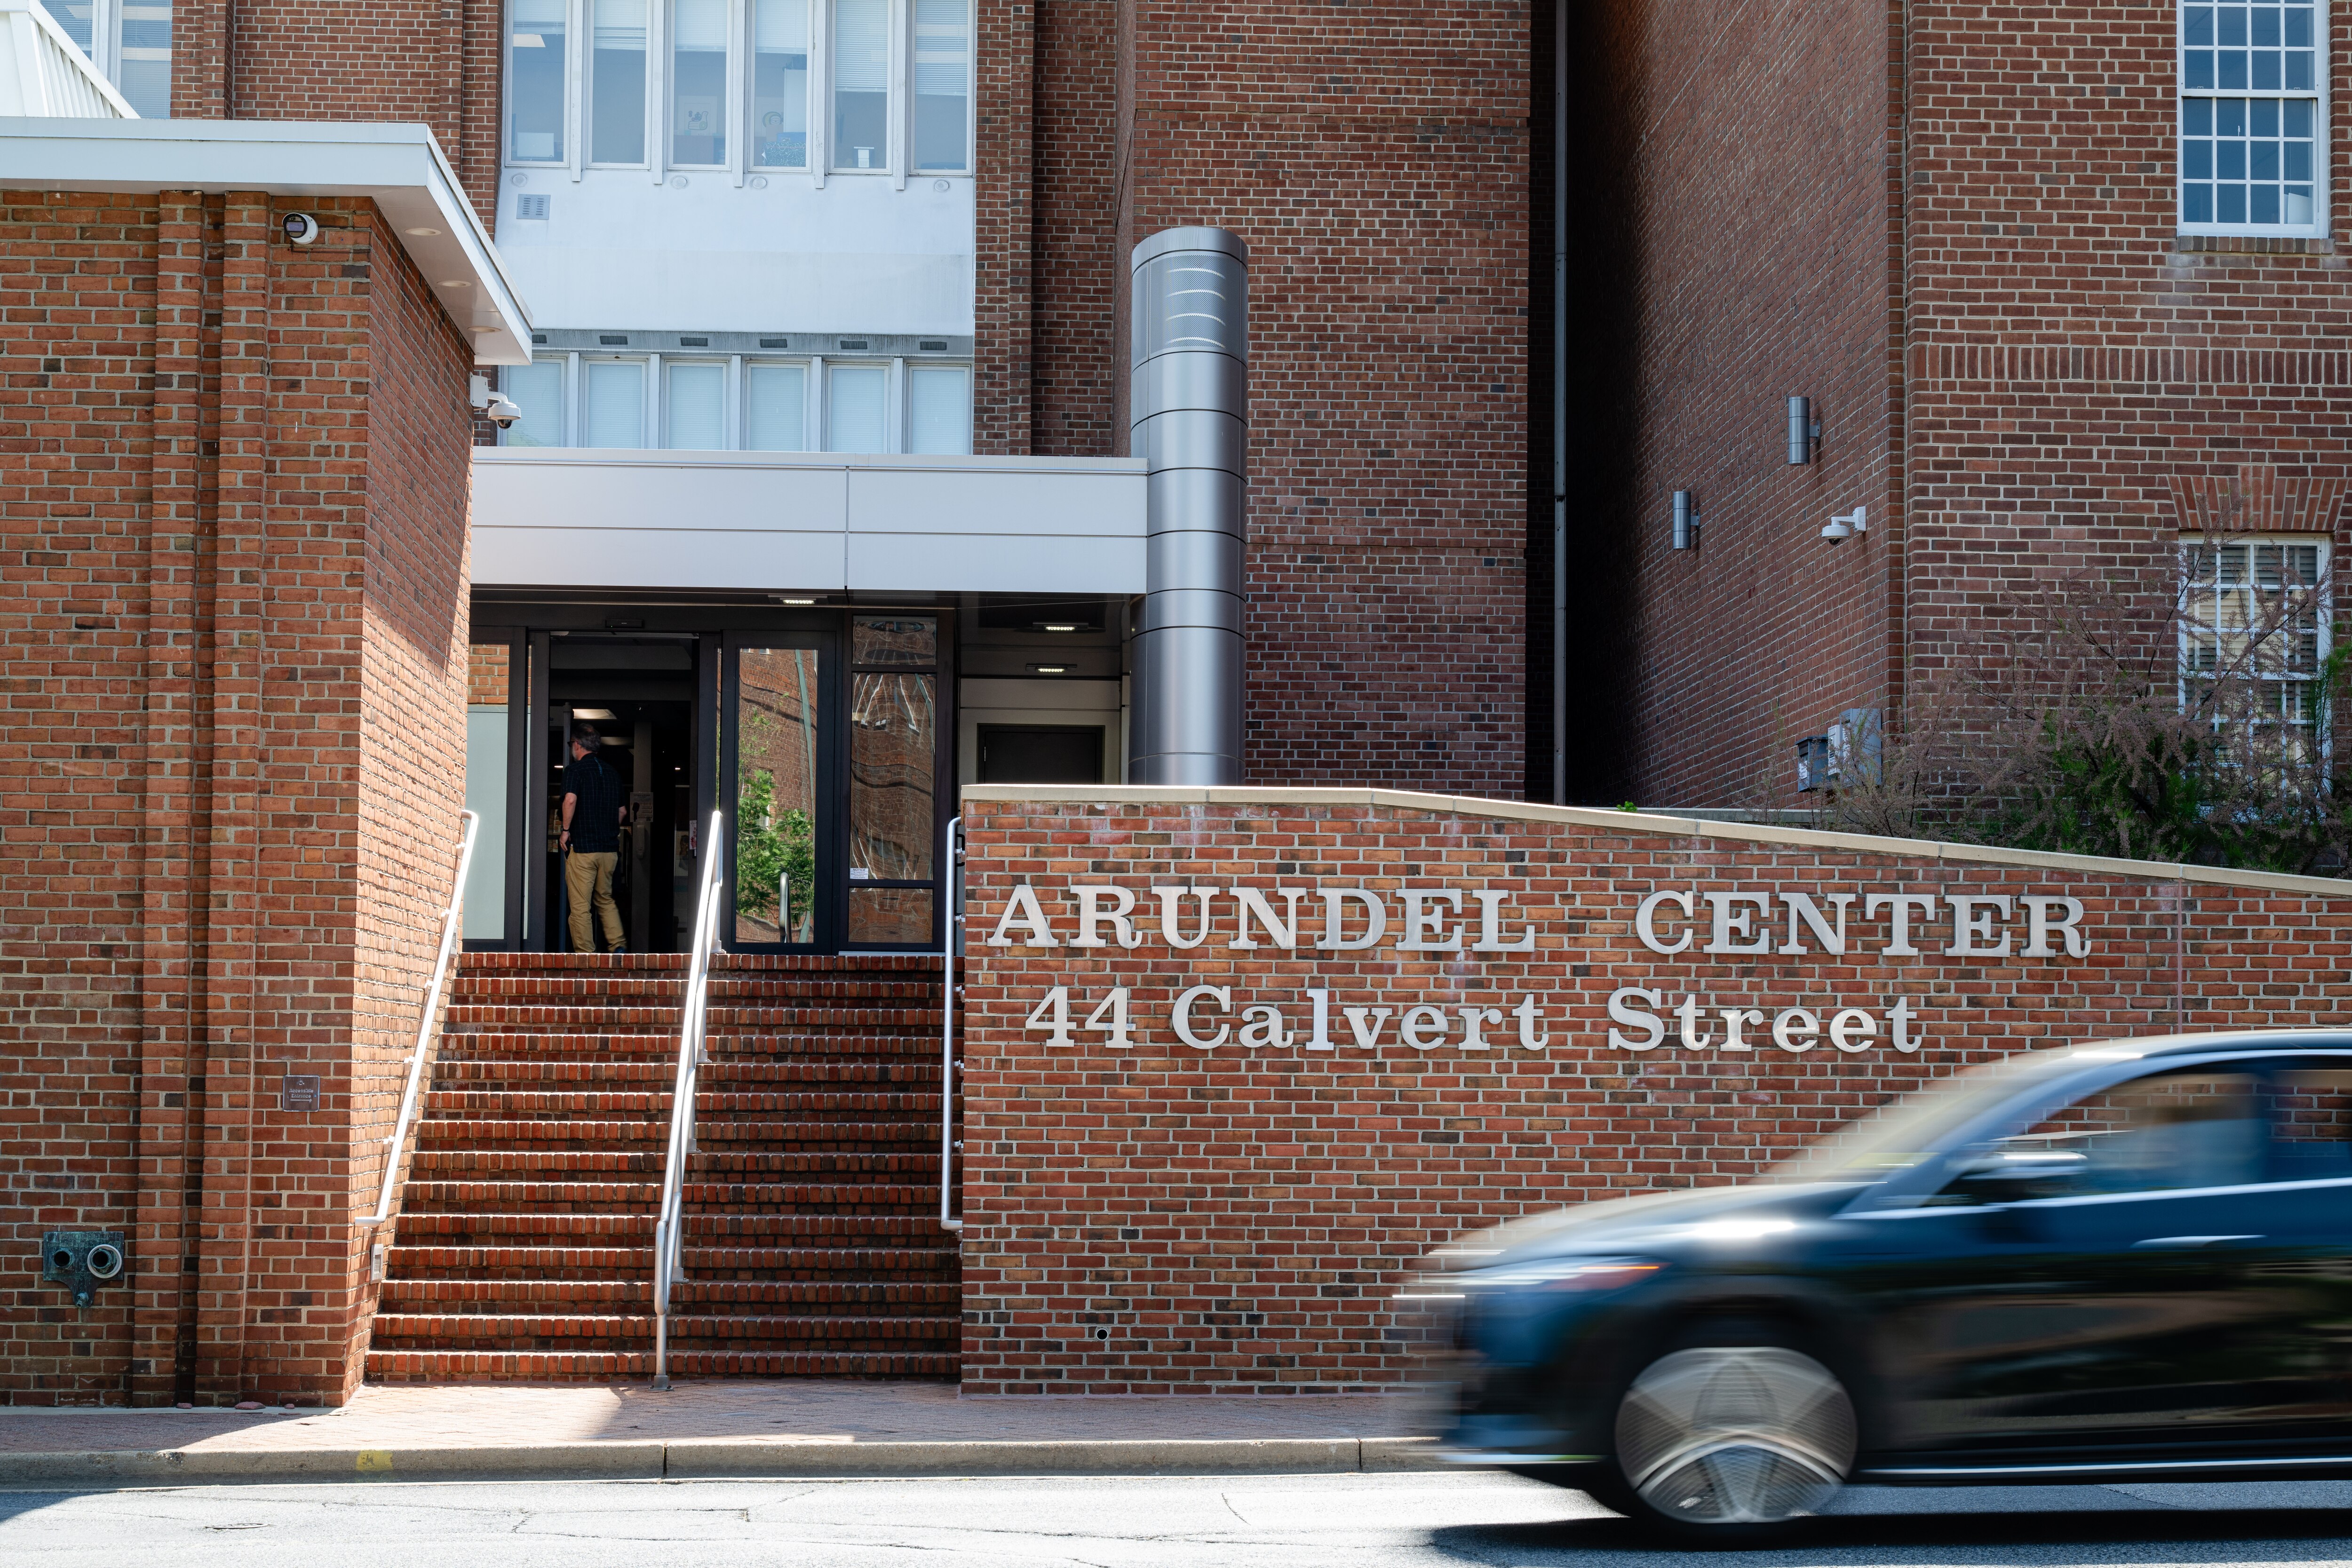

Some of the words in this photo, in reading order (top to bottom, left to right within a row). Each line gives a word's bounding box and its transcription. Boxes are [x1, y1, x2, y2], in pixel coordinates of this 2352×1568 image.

[987, 884, 1535, 952] ARUNDEL
[1635, 890, 2091, 959] CENTER
[1025, 986, 1136, 1049] 44
[1171, 984, 1549, 1051] Calvert
[1607, 987, 1923, 1053] Street
